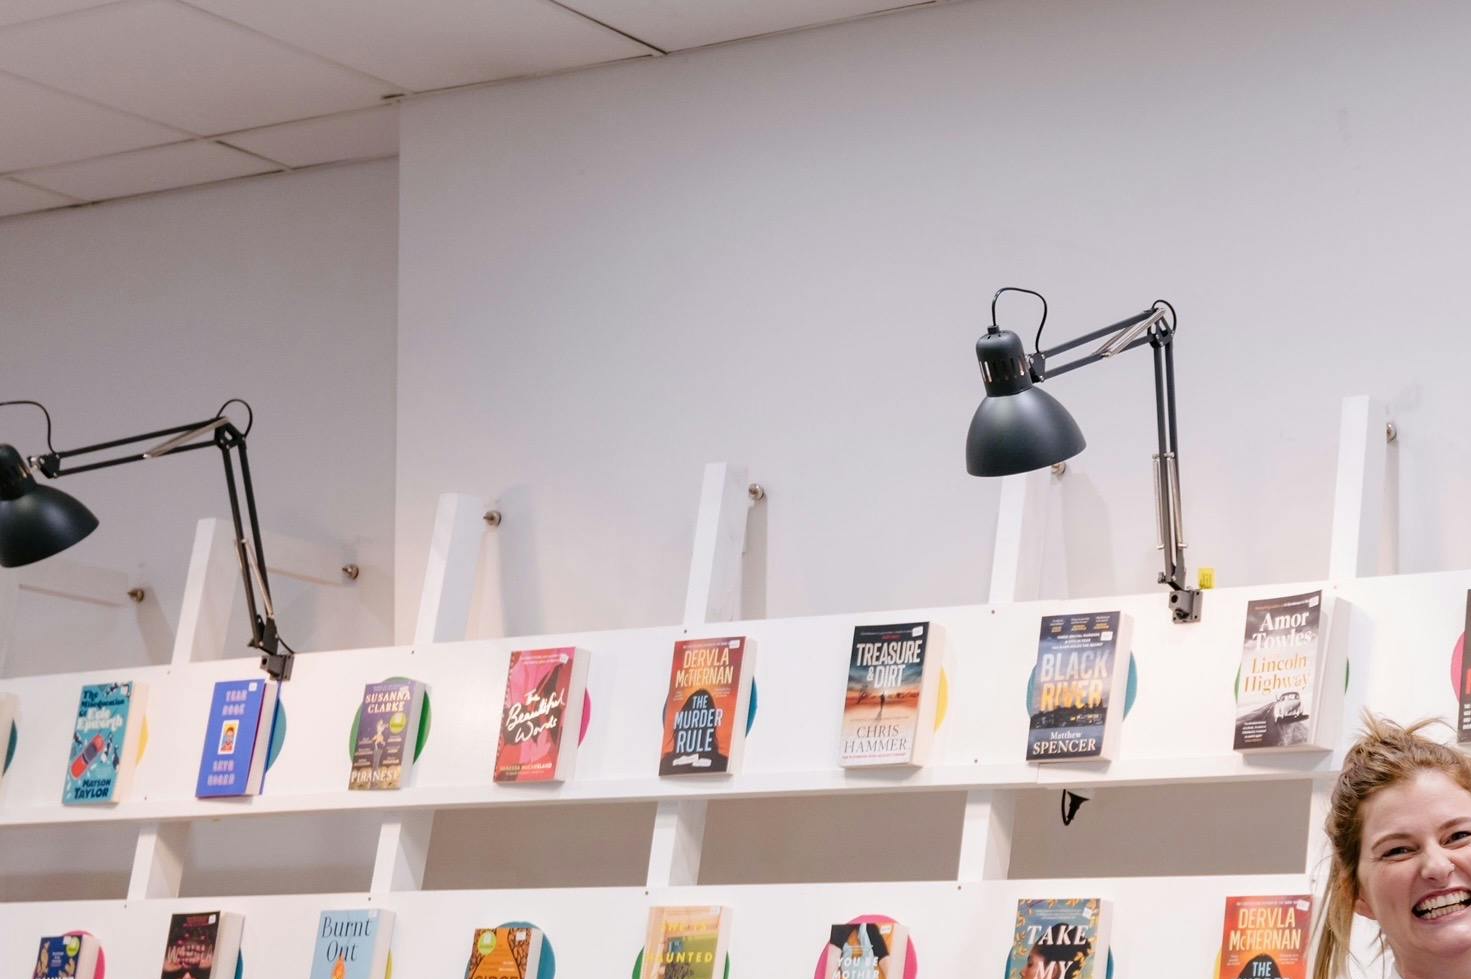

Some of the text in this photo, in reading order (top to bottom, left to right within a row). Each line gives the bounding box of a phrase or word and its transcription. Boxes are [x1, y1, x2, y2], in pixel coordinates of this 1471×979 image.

[1259, 612, 1310, 632] Amor
[683, 647, 730, 669] DERVLA
[855, 640, 923, 667] TREASURE
[1040, 651, 1111, 682] BLACK
[1251, 655, 1307, 675] Lincoln
[867, 664, 905, 689] & DIRT
[366, 690, 412, 705] SUSANNA
[693, 695, 709, 709] THE
[368, 702, 405, 716] CLARKE
[673, 708, 724, 731] MURDER
[515, 717, 558, 744] Words
[857, 724, 900, 737] CHRIS
[676, 729, 714, 754] RULE
[844, 738, 909, 754] HAMMER
[1032, 738, 1097, 756] SPENCER
[74, 788, 110, 800] TAYLOR
[320, 916, 372, 938] Burnt
[1238, 907, 1296, 930] DERVLA
[1026, 925, 1088, 946] TAKE
[326, 941, 359, 962] Out
[1253, 962, 1273, 977] THE
